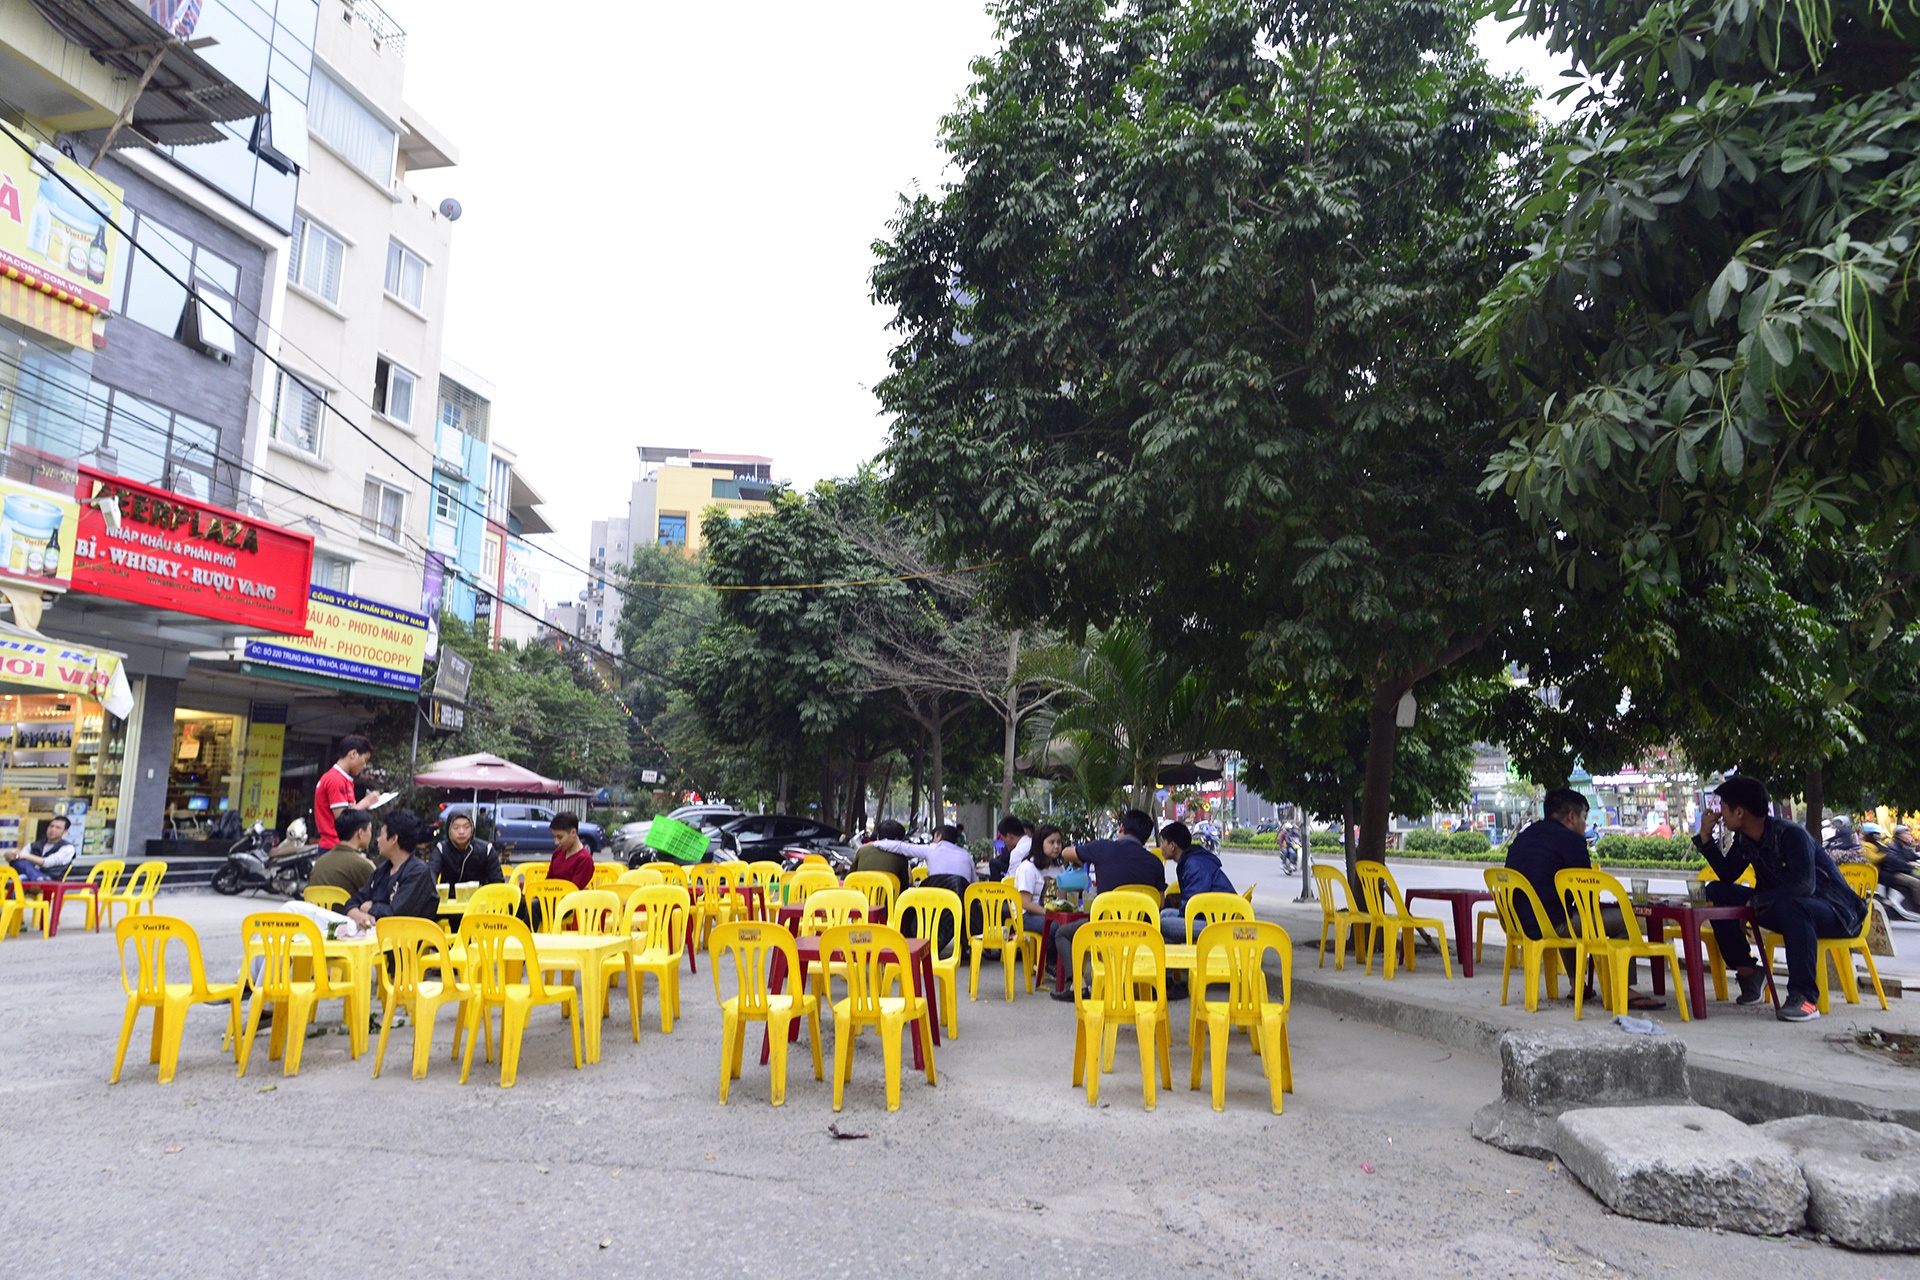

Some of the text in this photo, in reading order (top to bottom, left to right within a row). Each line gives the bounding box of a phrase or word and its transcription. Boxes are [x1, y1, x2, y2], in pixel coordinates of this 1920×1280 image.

[140, 532, 171, 551] KHẨU
[213, 552, 237, 568] PHỐI
[110, 547, 182, 578] WHISKY
[191, 567, 234, 592] RƯỢU
[237, 578, 276, 601] VANG
[306, 606, 324, 624] ÀU
[348, 619, 379, 637] PHOTO
[380, 626, 400, 642] MÀU
[312, 590, 335, 603] CÔNG
[336, 597, 346, 605] TY
[395, 613, 409, 622] VIỆT
[410, 617, 425, 627] NAM
[337, 641, 412, 668] PHOTOCOPPY
